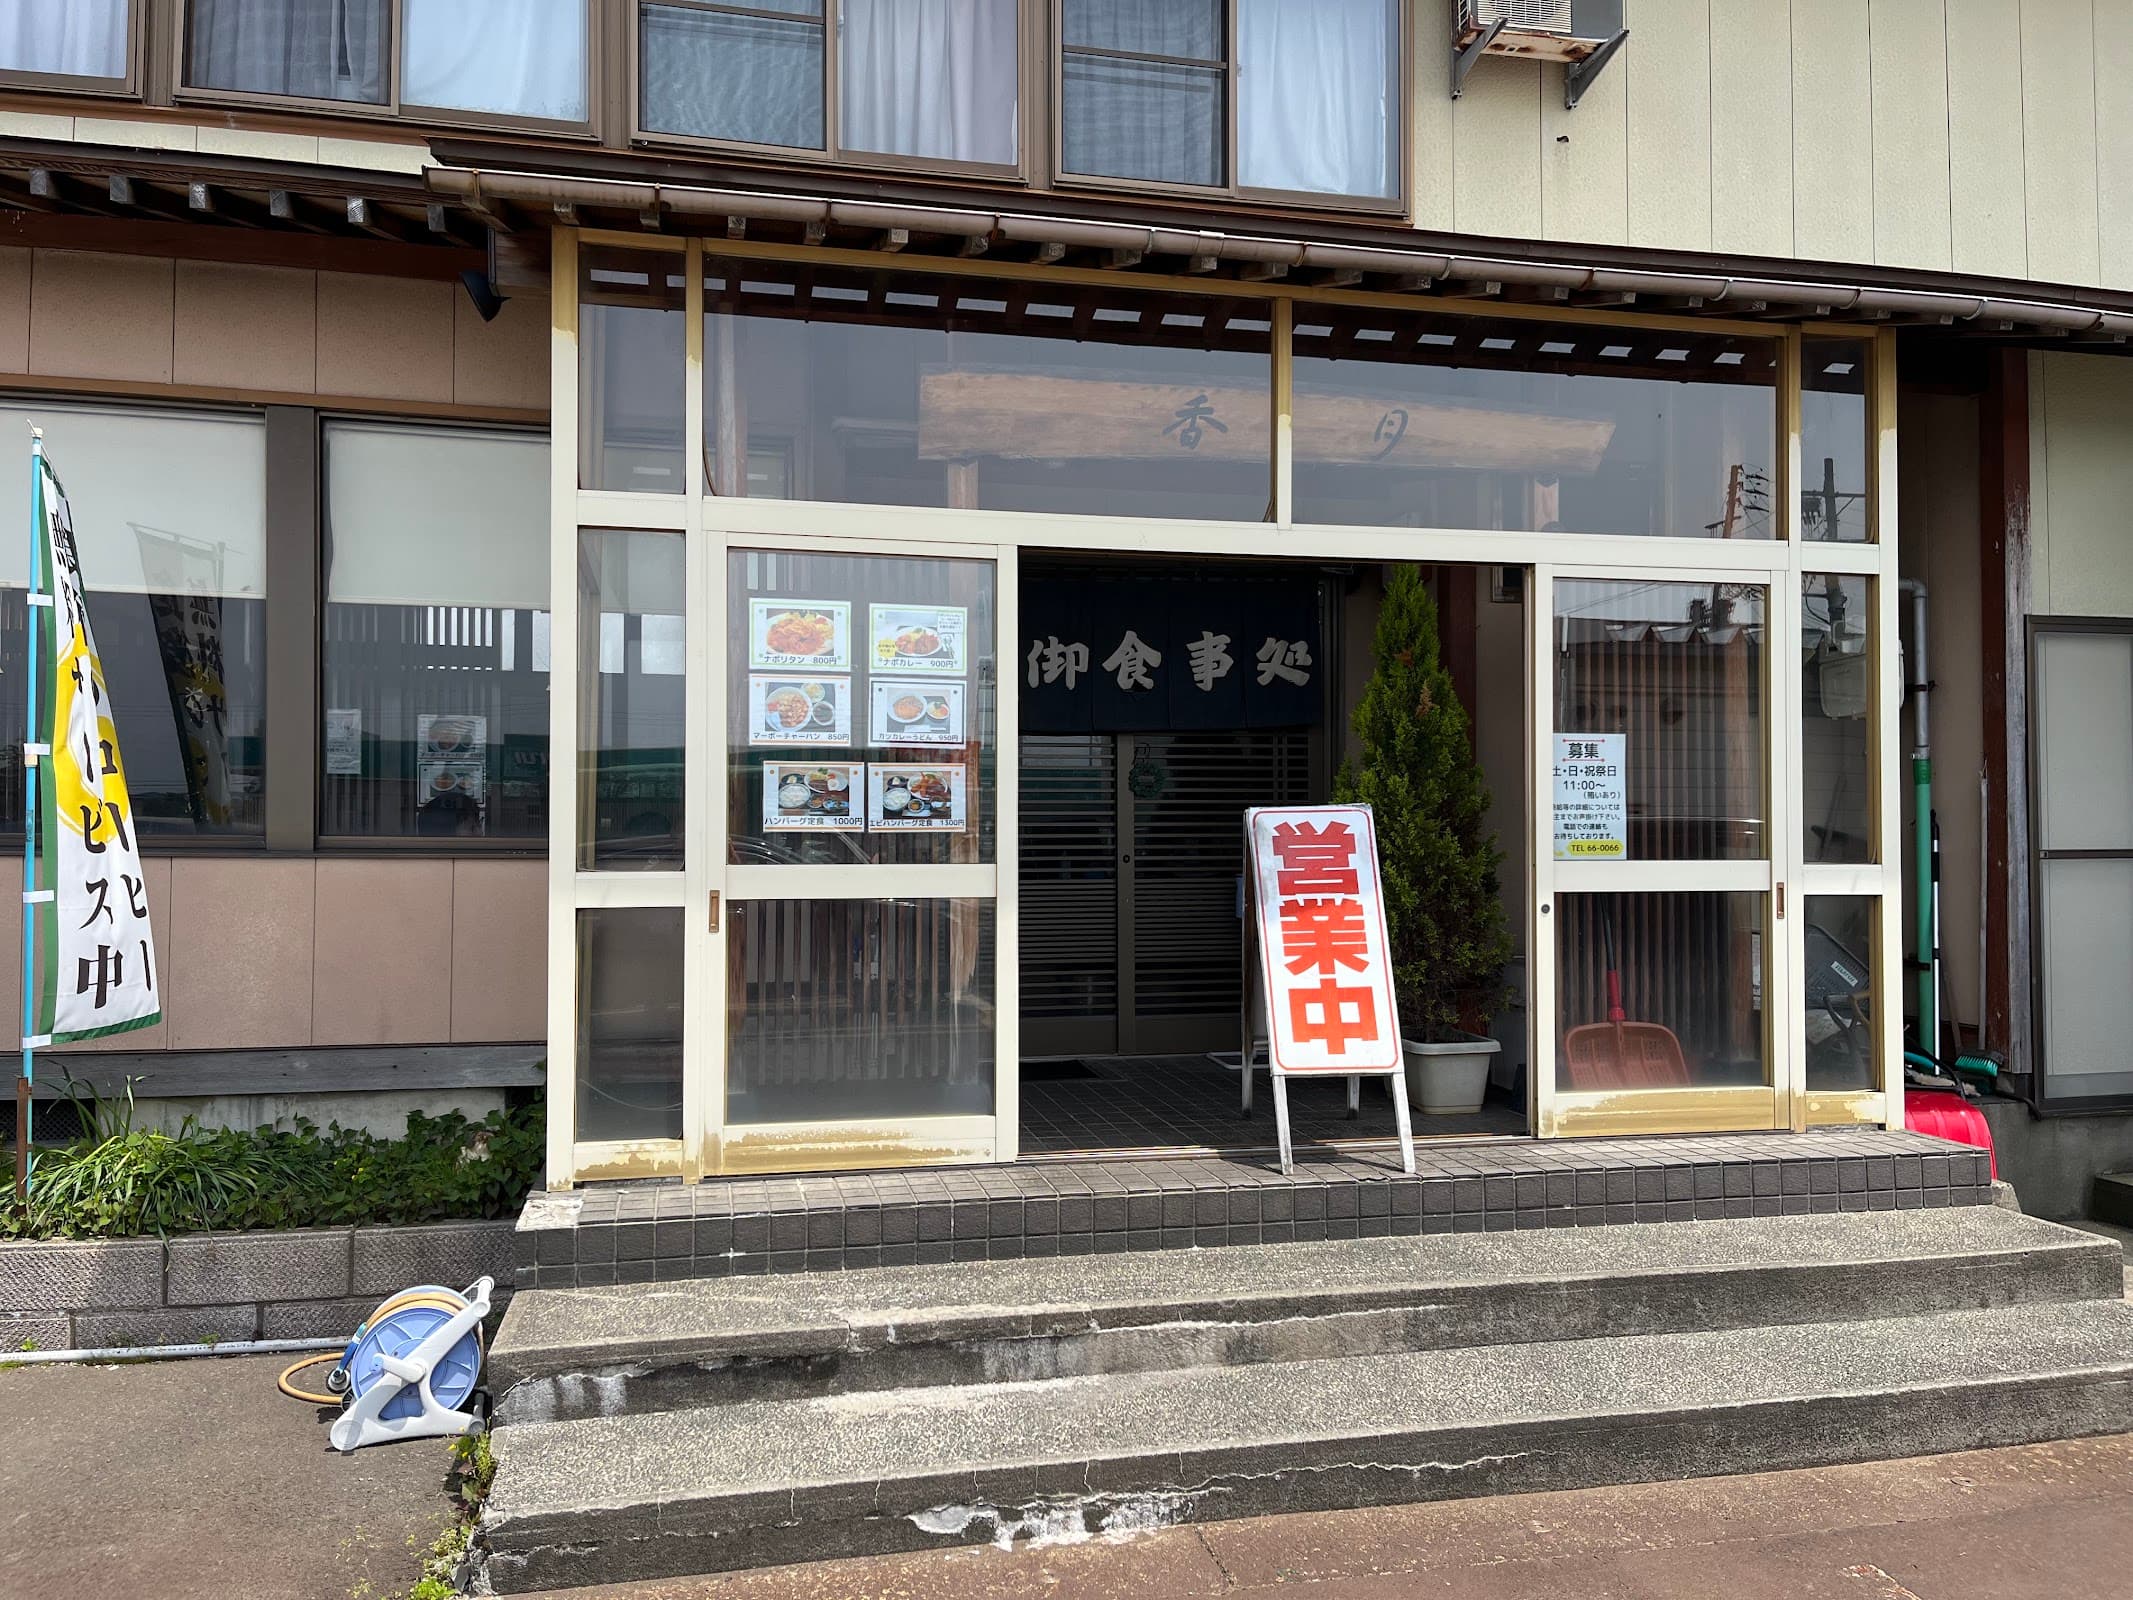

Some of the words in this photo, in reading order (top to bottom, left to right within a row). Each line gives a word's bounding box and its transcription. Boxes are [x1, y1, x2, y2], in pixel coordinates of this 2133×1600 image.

[763, 655, 806, 664] ナポリタン
[813, 656, 837, 665] 800円
[882, 658, 923, 667] ナポカレー
[930, 660, 954, 668] 900円
[1027, 630, 1313, 691] 御食事処
[753, 732, 821, 740] マーボーチャーハン
[828, 733, 850, 741] 850円
[1568, 743, 1599, 759] 募集
[764, 817, 825, 826] ハンバーグ定食
[833, 817, 863, 826] 1000円
[1571, 844, 1585, 852] TEL
[1587, 844, 1619, 852] 66-0066
[1272, 820, 1379, 1055] 営業中
